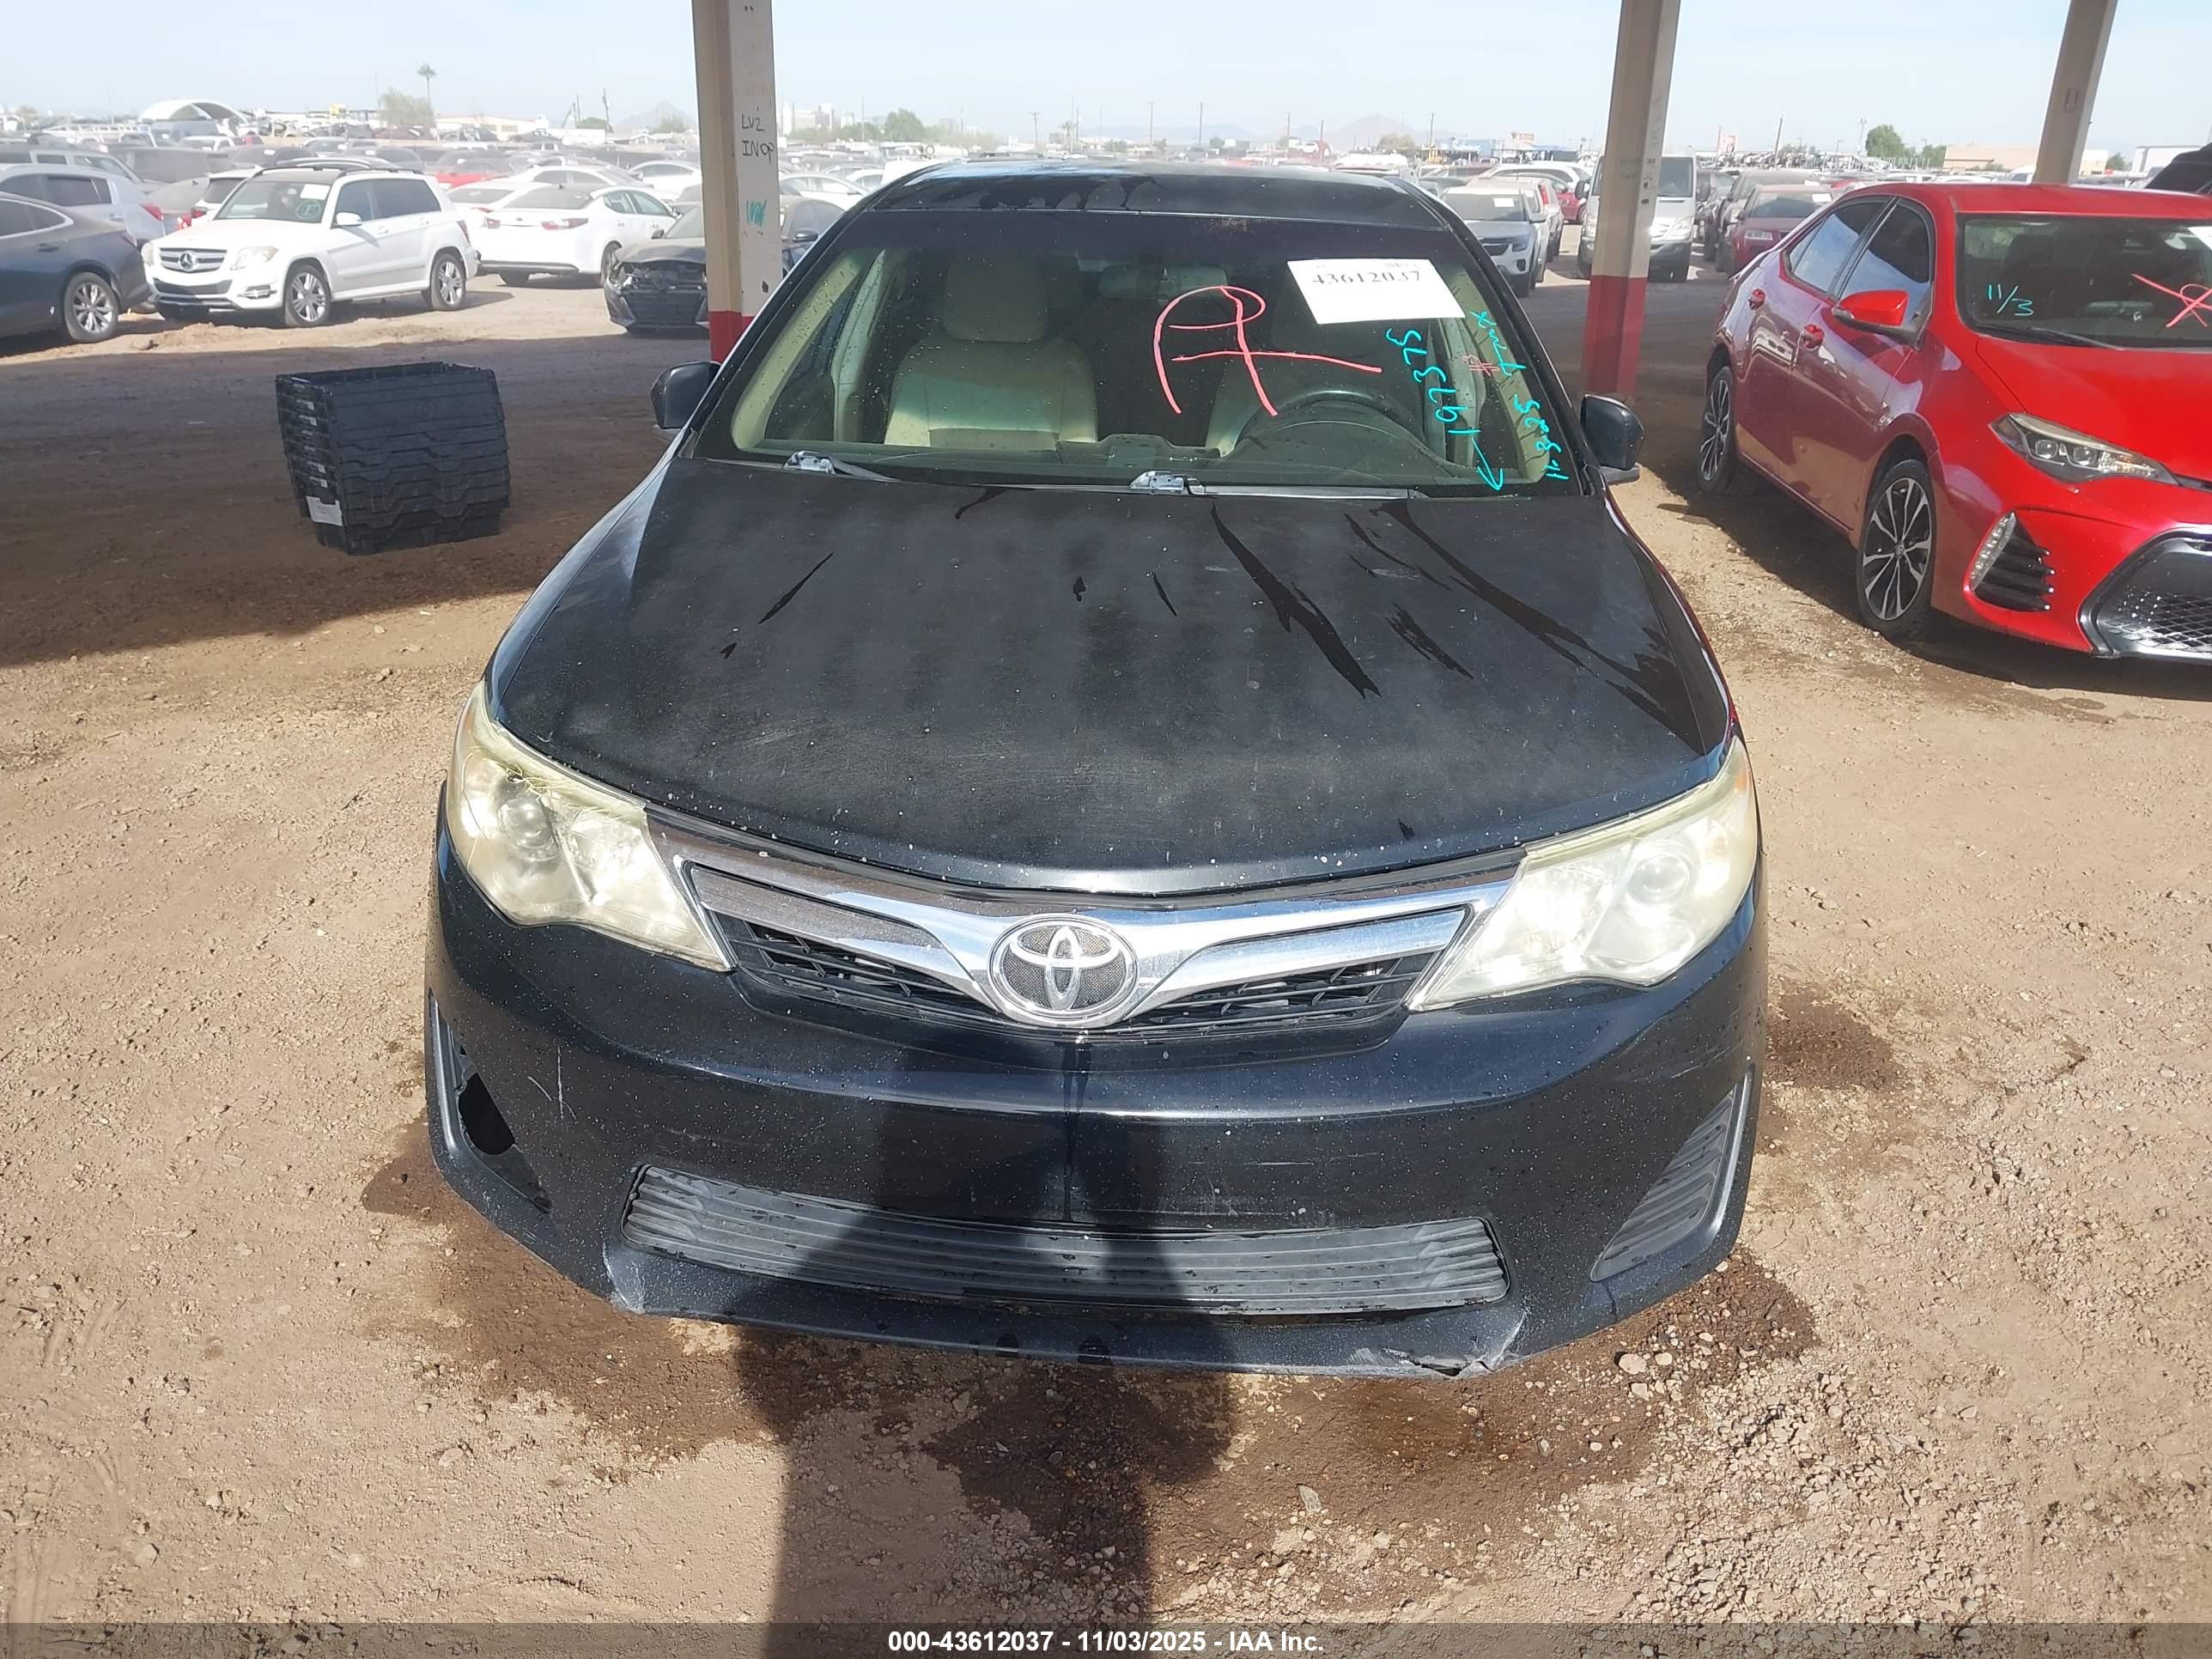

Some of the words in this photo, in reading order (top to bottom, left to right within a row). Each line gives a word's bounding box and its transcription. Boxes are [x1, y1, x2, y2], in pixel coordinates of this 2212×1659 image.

[1312, 270, 1421, 285] 43612037
[1986, 283, 2035, 317] 11/3
[1385, 327, 1482, 435] 197375
